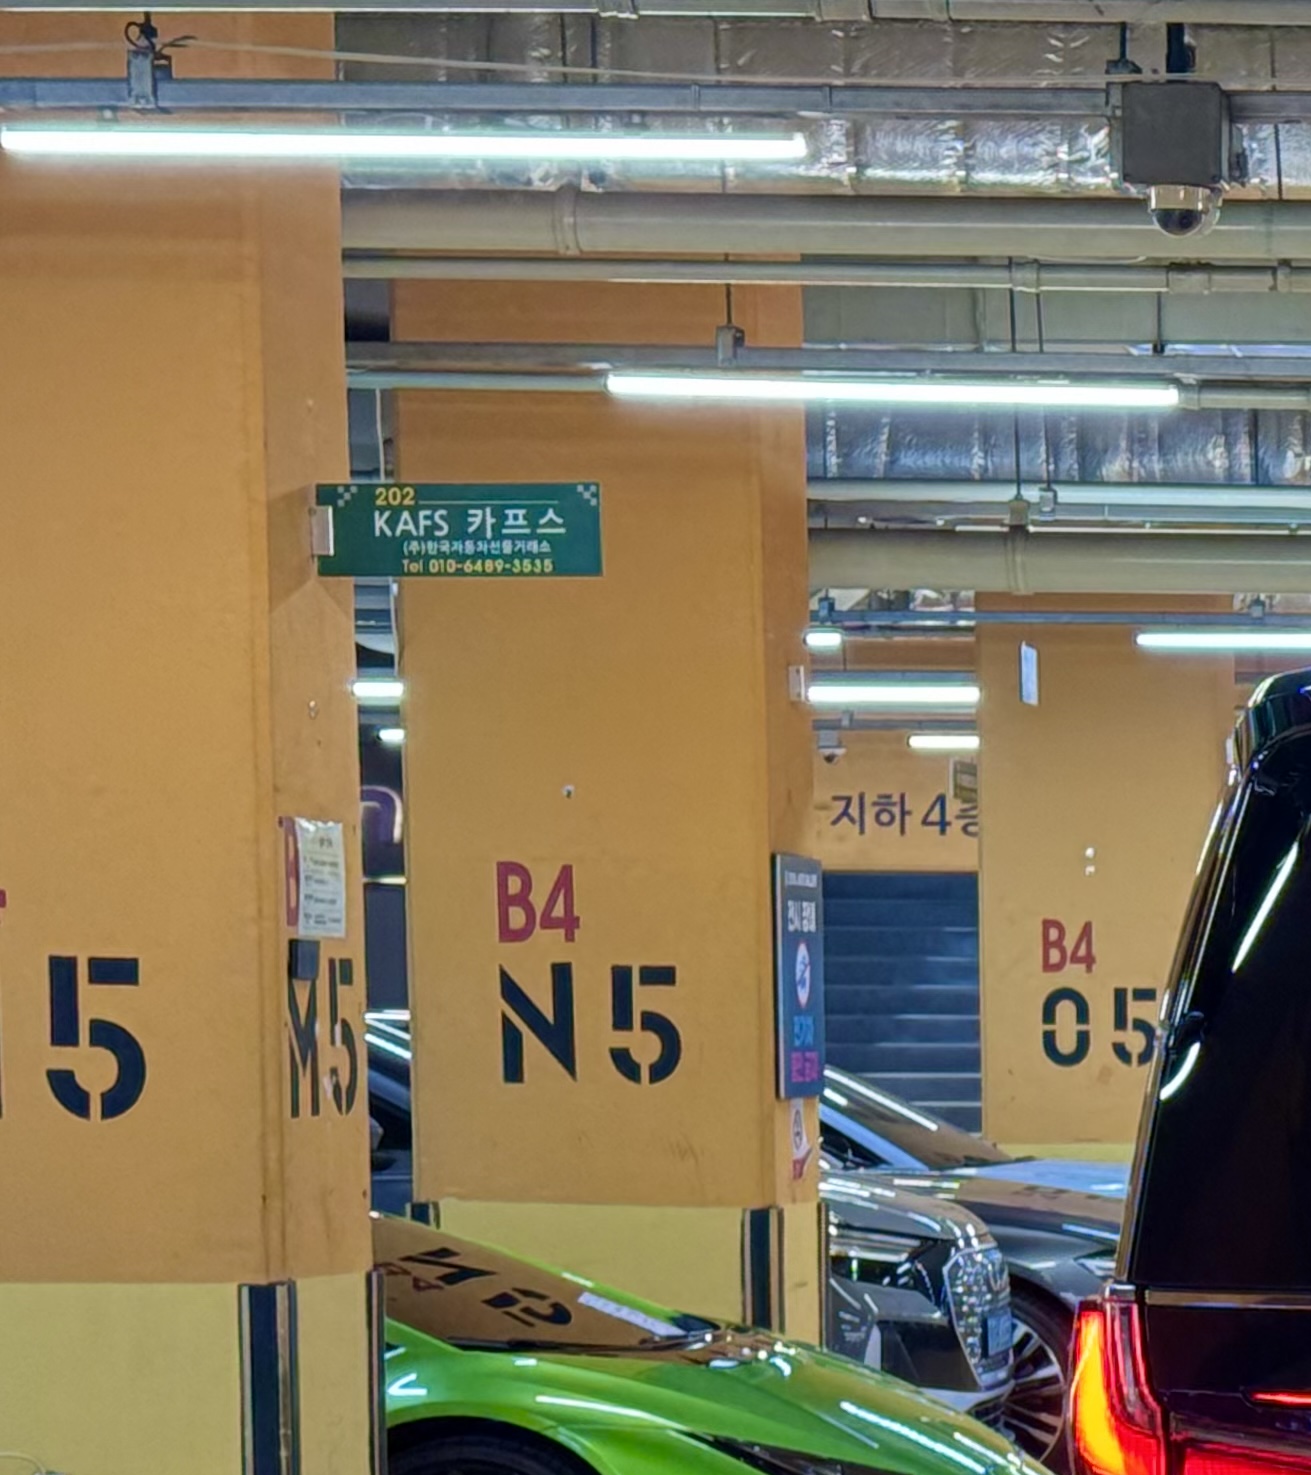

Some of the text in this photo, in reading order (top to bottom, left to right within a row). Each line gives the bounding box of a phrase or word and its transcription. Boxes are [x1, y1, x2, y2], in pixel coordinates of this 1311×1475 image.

[375, 487, 415, 506] 202
[374, 507, 567, 540] KAFS 카프스
[402, 559, 423, 572] Tel
[496, 861, 580, 943] B4
[1041, 918, 1096, 974] B4
